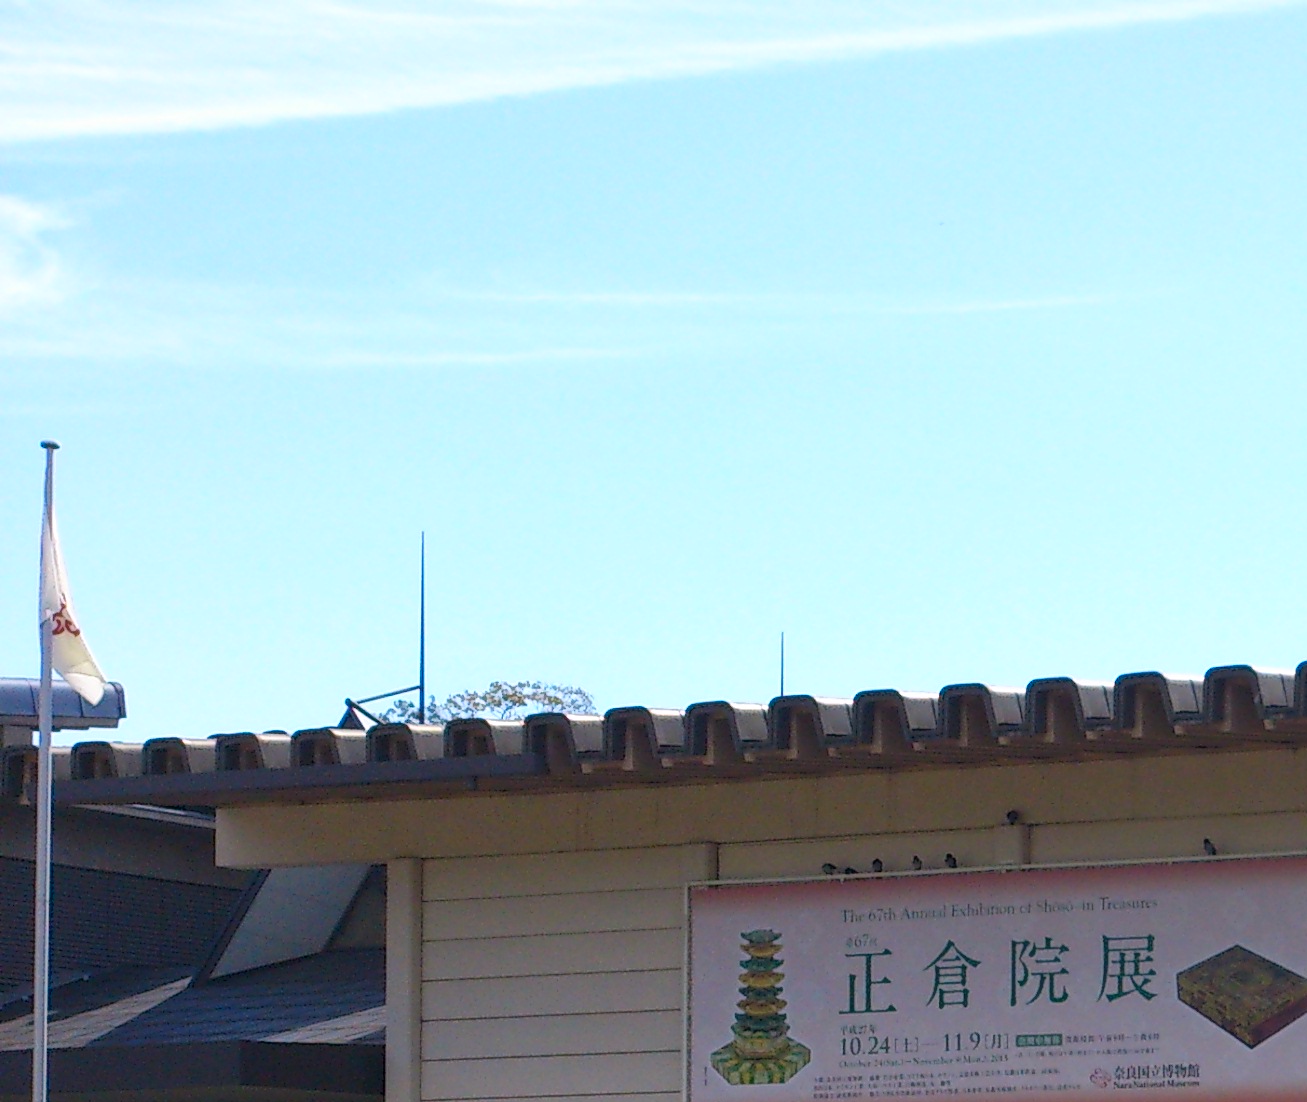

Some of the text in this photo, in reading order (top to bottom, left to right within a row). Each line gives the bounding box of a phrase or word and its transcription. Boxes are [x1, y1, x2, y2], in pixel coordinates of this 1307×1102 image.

[841, 908, 866, 923] The
[868, 907, 896, 922] 67th
[900, 904, 947, 920] Annual
[951, 902, 1015, 918] Exhibition
[1019, 901, 1032, 914] of
[1100, 896, 1158, 911] Treasures
[838, 932, 1159, 1016] 正倉院展
[1113, 1063, 1200, 1080] 奈良国立博物館
[1113, 1080, 1200, 1090] Nara National Museum
